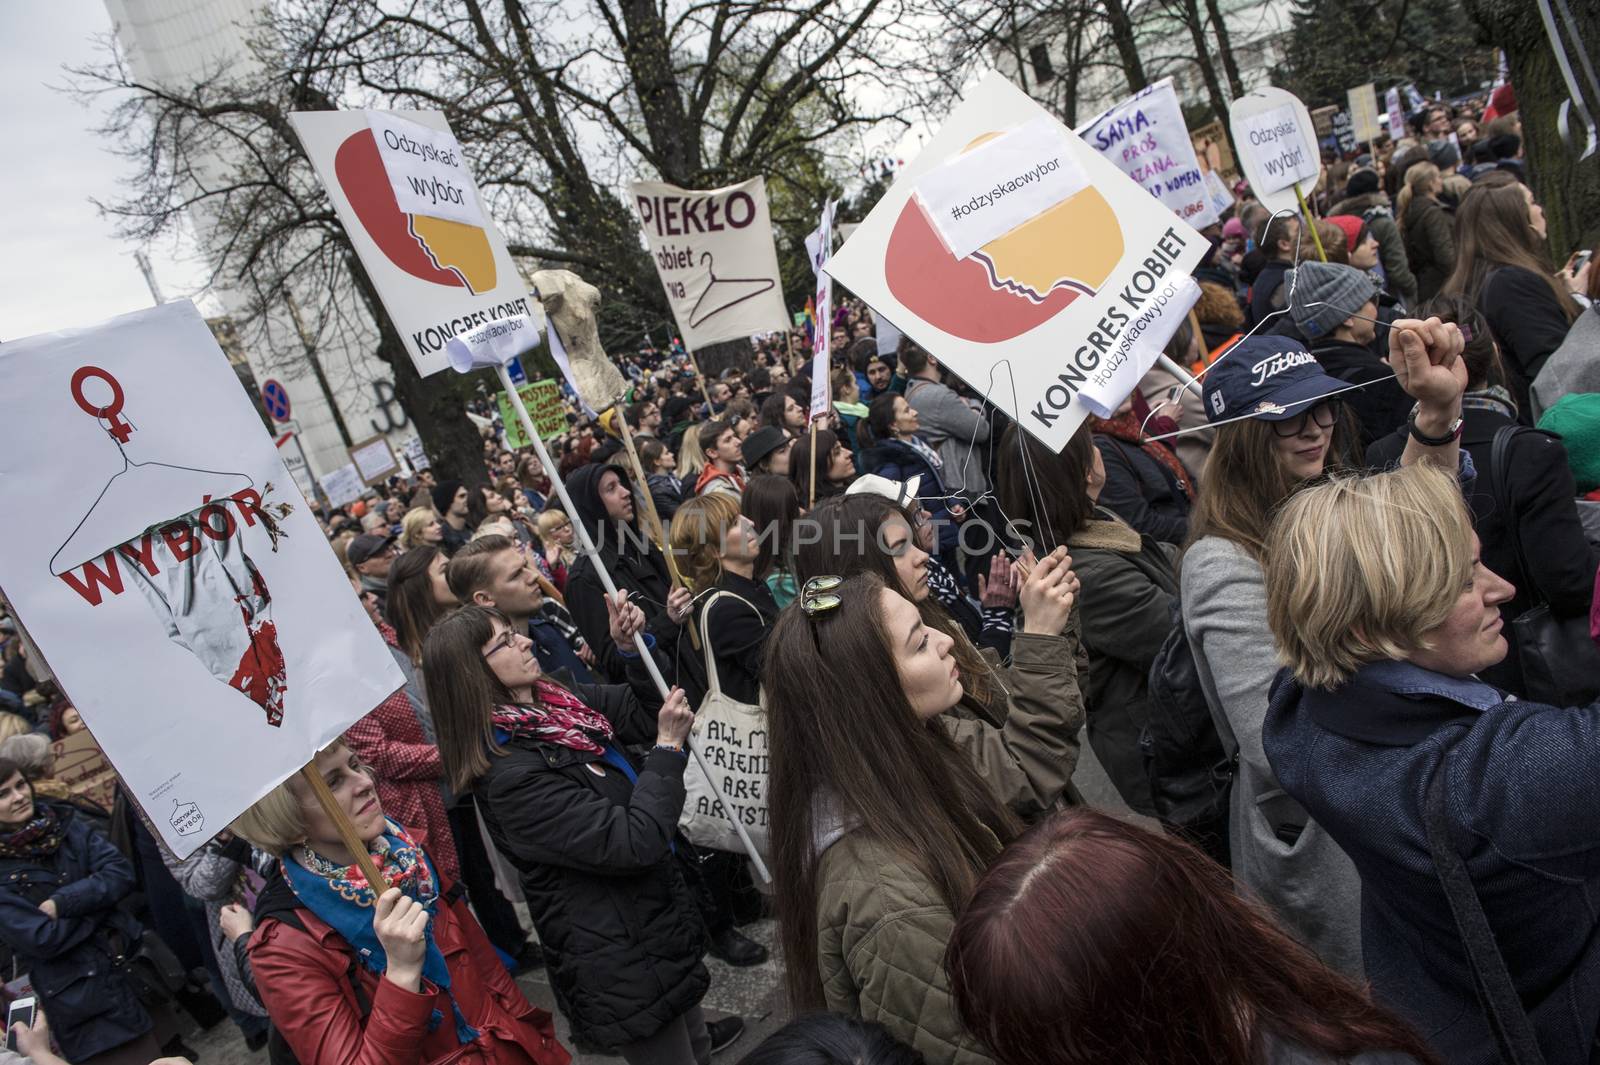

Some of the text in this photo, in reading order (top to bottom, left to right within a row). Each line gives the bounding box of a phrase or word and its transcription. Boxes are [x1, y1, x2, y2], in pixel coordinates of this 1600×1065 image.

[1095, 109, 1157, 151] SAMA.
[1250, 119, 1296, 147] Odzyskać
[383, 129, 459, 169] Odzyskać
[406, 175, 464, 206] wybór
[951, 156, 1061, 222] #odzyskacwybor
[1165, 169, 1201, 192] WOMEN
[637, 191, 756, 237] PIEKŁO
[656, 244, 694, 270] obiet
[1030, 227, 1187, 429] KONGRES KOBIET
[1092, 280, 1179, 388] #odzyskacwybor
[59, 487, 264, 607] WYBÓR
[707, 720, 768, 749] ALL M
[723, 775, 761, 800] ARE
[178, 813, 201, 833] WYBÓR
